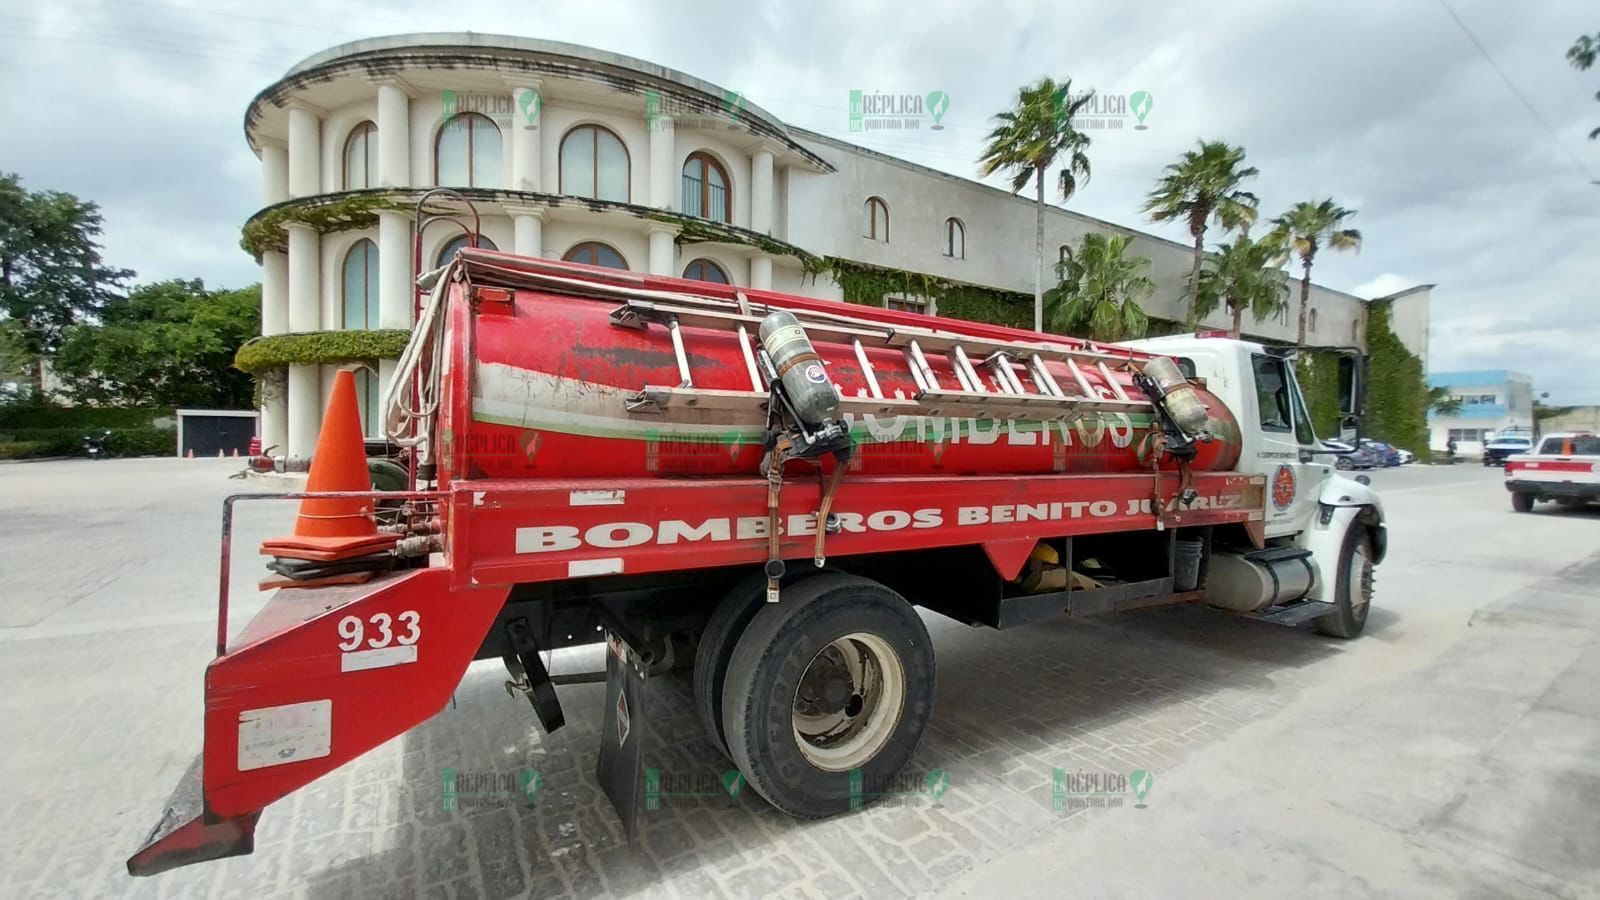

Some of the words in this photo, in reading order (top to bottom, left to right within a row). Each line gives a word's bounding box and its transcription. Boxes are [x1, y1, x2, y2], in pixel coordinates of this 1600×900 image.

[516, 508, 943, 553] BOMBEROS
[958, 500, 1118, 525] BENITO
[338, 610, 421, 652] 933
